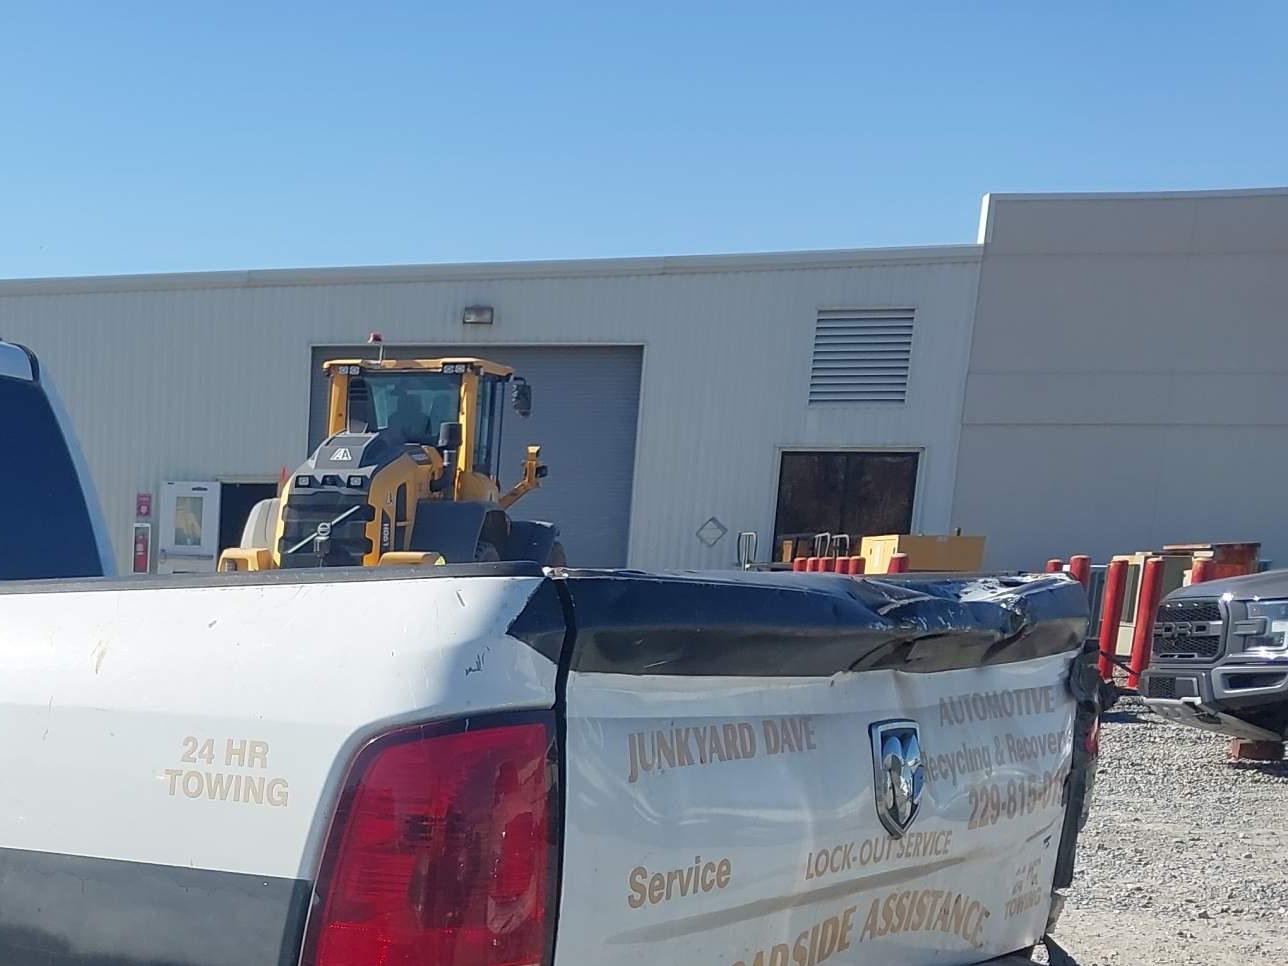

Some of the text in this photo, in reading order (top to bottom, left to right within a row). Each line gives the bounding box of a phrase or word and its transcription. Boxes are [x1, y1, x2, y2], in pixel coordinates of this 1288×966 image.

[938, 685, 1056, 728] AUTOMOTIVE
[180, 735, 270, 769] 24 HR
[627, 717, 817, 784] JUNKYARD DAVE
[164, 768, 289, 808] TOWING
[805, 830, 953, 881] LOCK-OUT SERVICE
[627, 855, 732, 909] Service
[859, 889, 991, 948] ASSISTANCE
